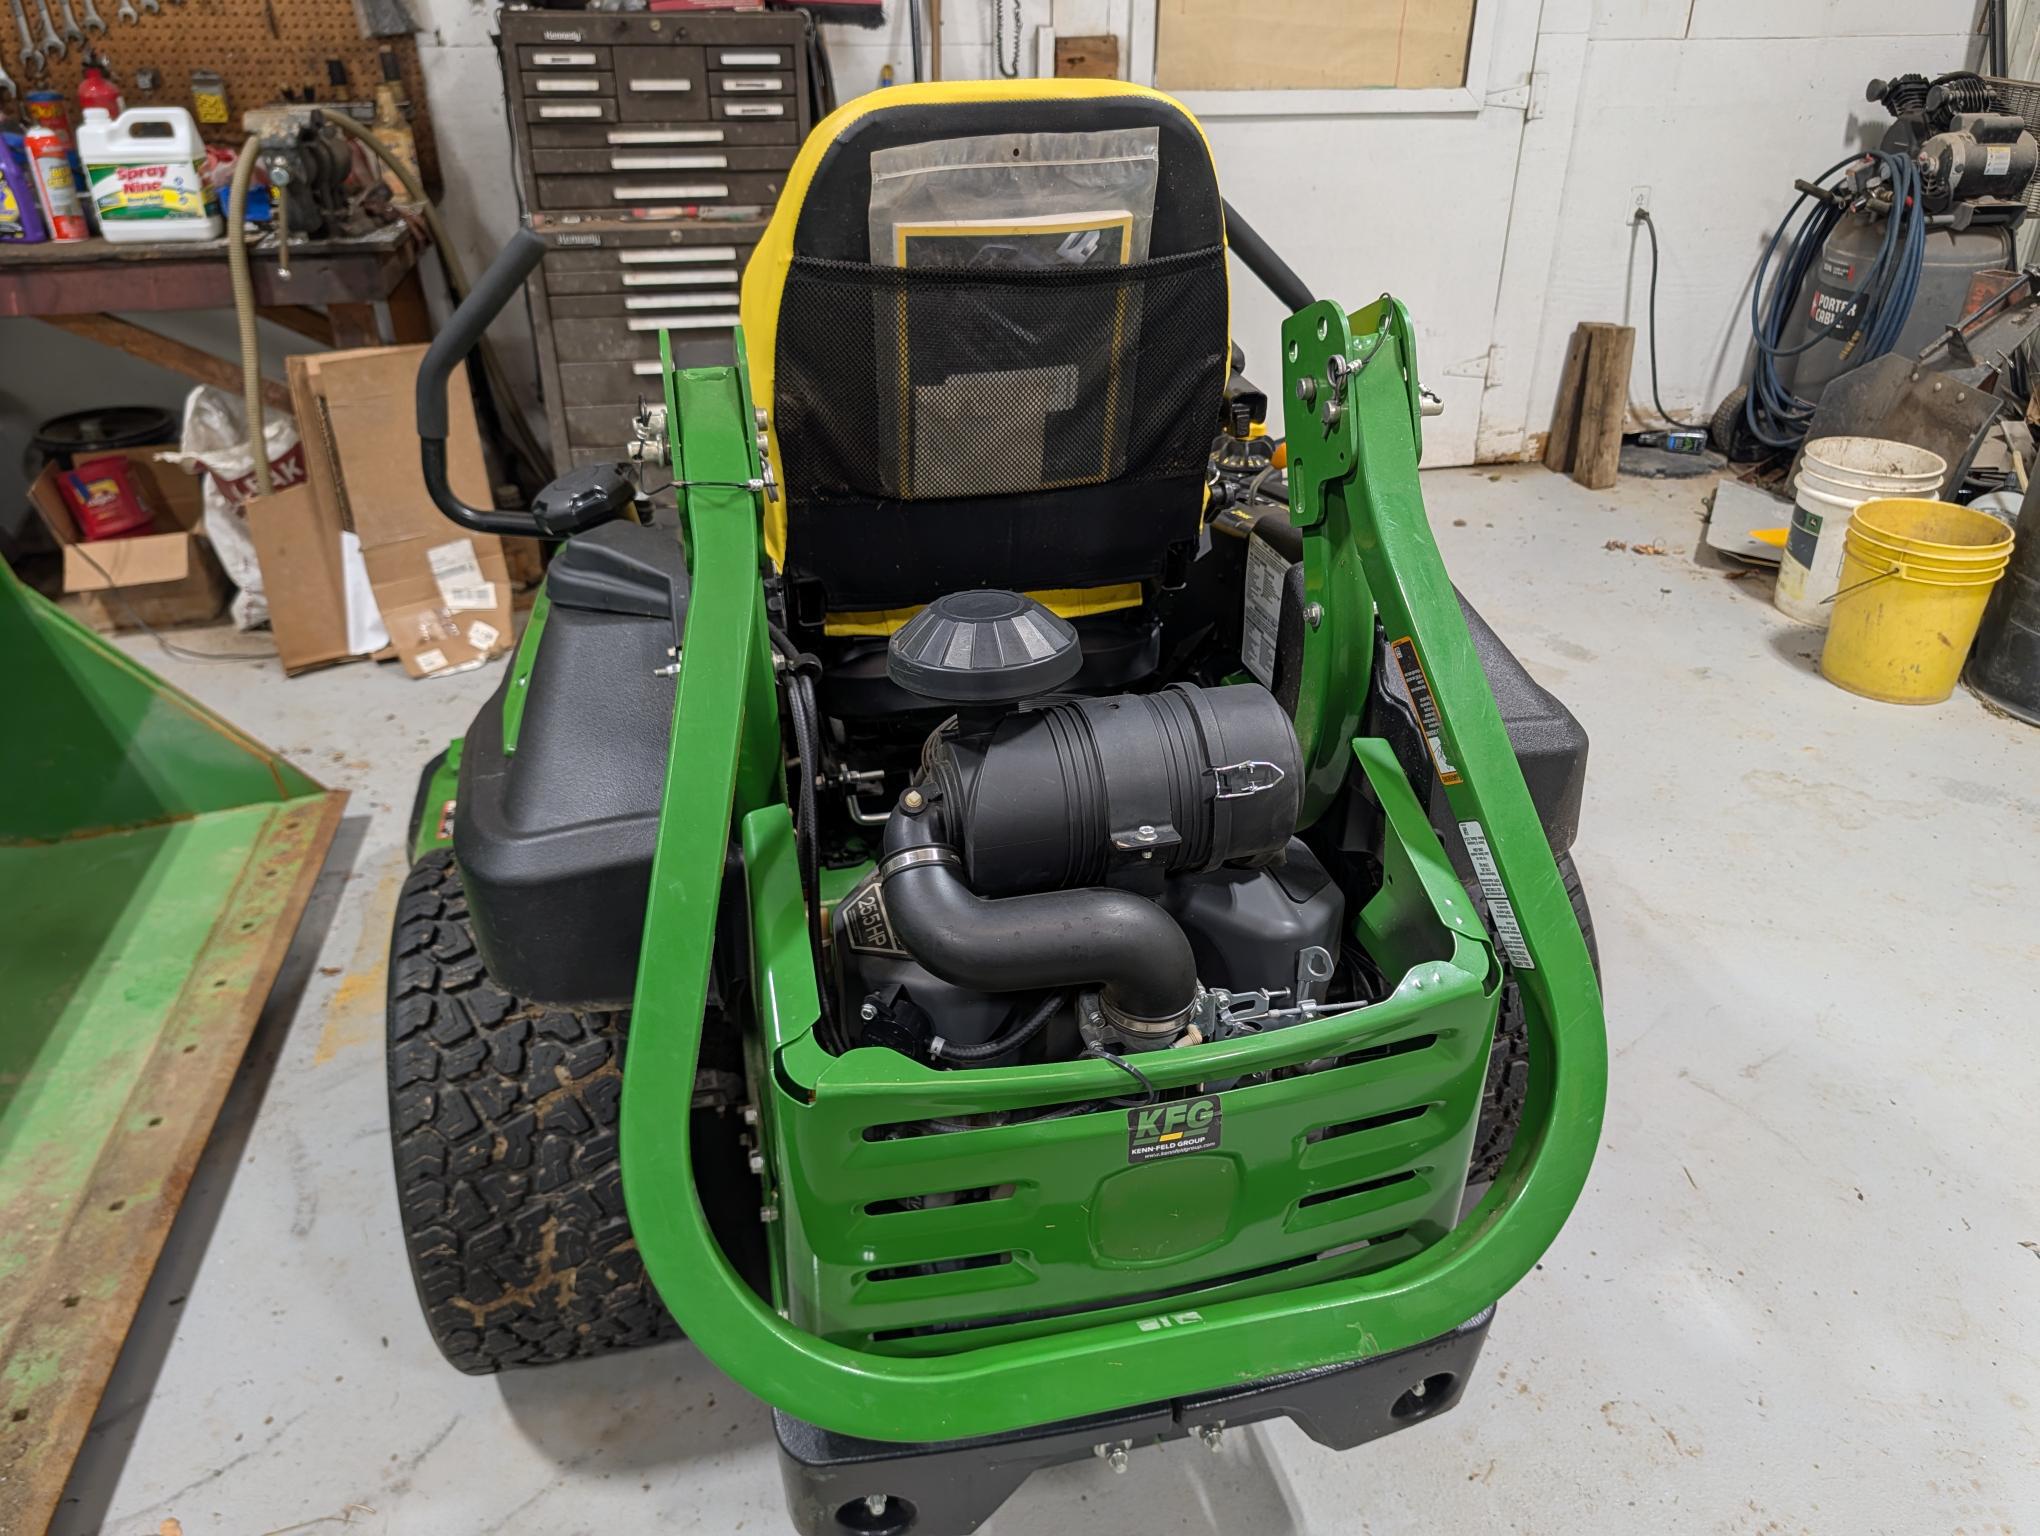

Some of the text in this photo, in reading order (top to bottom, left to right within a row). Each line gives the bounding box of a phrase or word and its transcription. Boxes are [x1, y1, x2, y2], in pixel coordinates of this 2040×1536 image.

[543, 30, 582, 43] Kennedy
[116, 165, 168, 182] Spray
[123, 182, 162, 195] Nine
[1135, 1100, 1214, 1138] KFG
[1131, 1136, 1207, 1155] KENN-FELD GROUP
